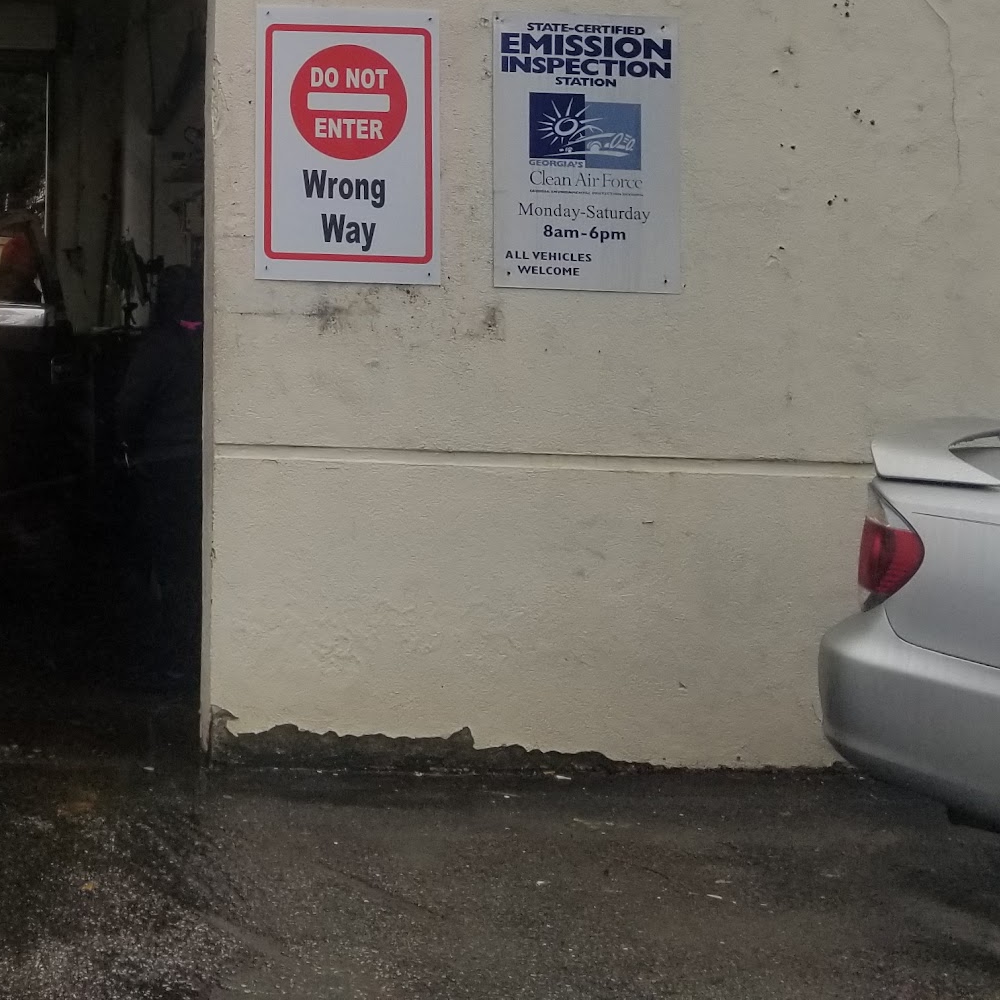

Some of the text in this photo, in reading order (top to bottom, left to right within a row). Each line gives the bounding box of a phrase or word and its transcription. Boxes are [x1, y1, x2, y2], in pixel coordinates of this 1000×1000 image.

[527, 22, 645, 36] STATE-CERTIFIED
[501, 33, 672, 60] EMISSION
[310, 67, 388, 89] DO NOT
[501, 56, 672, 79] INSPECTION
[555, 77, 617, 87] STATION
[315, 118, 383, 139] ENTER
[529, 159, 584, 168] GEORGIA'S
[303, 169, 386, 208] Wrong
[518, 202, 651, 223] Monday-Saturday
[321, 213, 376, 251] Way
[543, 225, 626, 243] 8am-6pm
[505, 251, 592, 262] ALL VEHICLES
[517, 265, 580, 276] WELCOME
